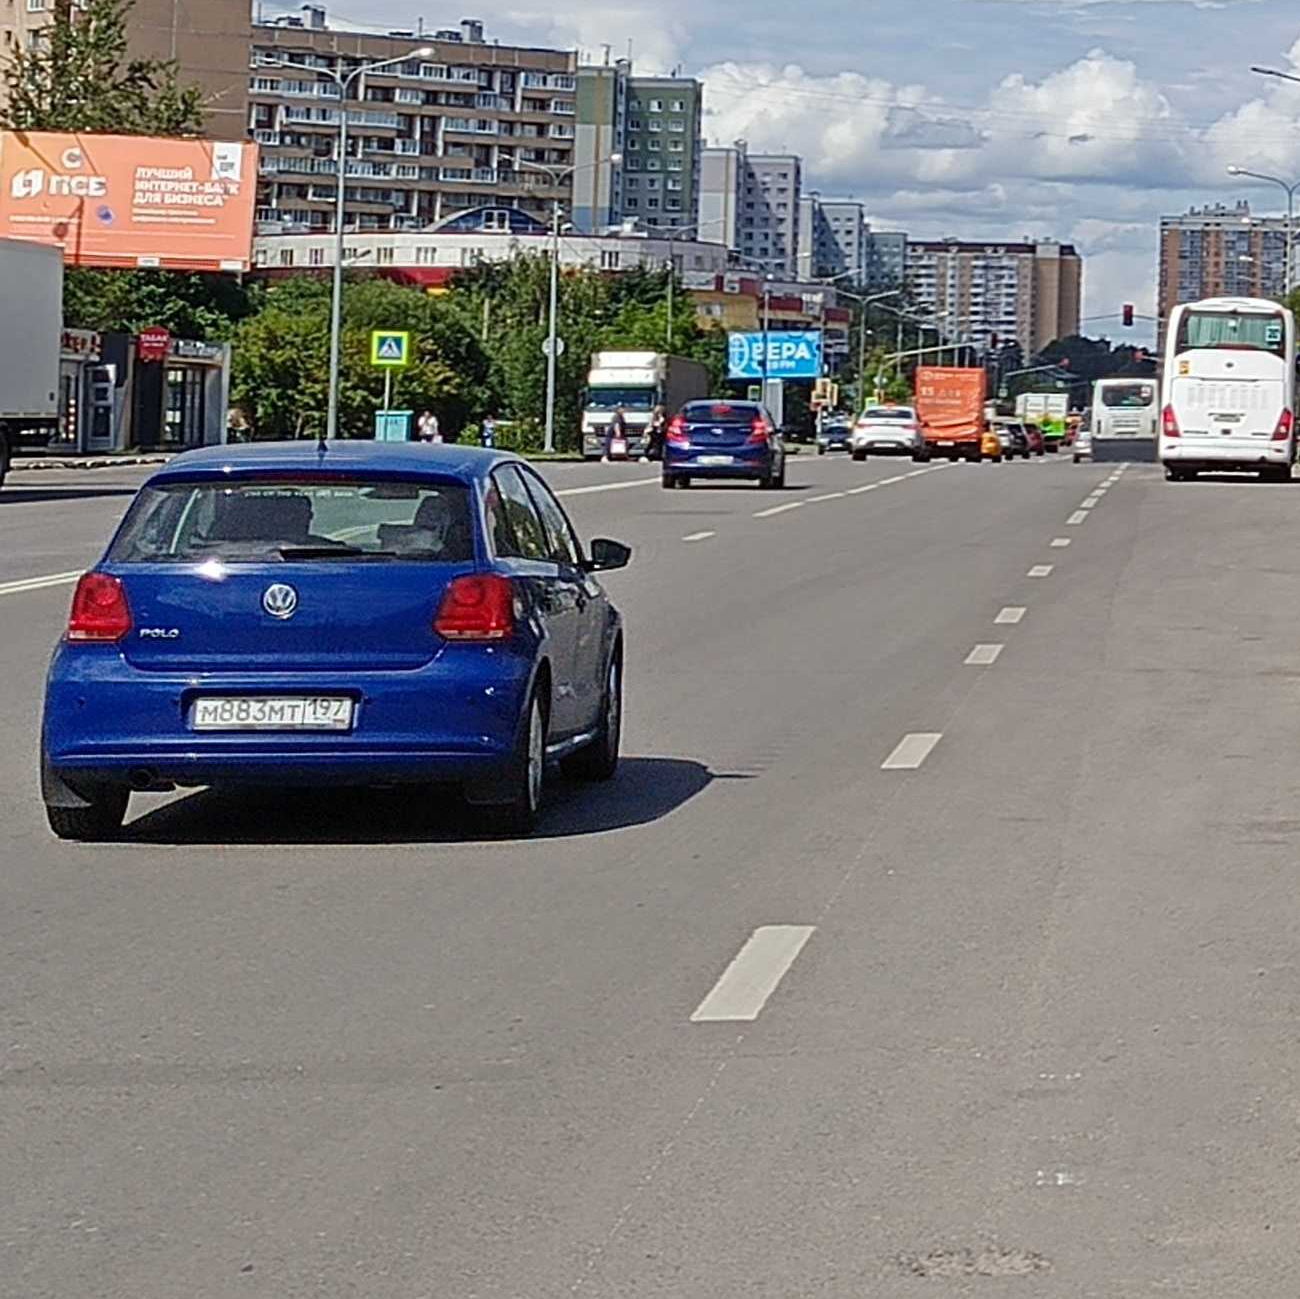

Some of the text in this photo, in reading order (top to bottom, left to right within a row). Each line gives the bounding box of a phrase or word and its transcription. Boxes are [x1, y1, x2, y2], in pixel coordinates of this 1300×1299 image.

[751, 341, 811, 360] ВЕРА
[139, 628, 180, 638] POLO
[308, 698, 345, 716] 197
